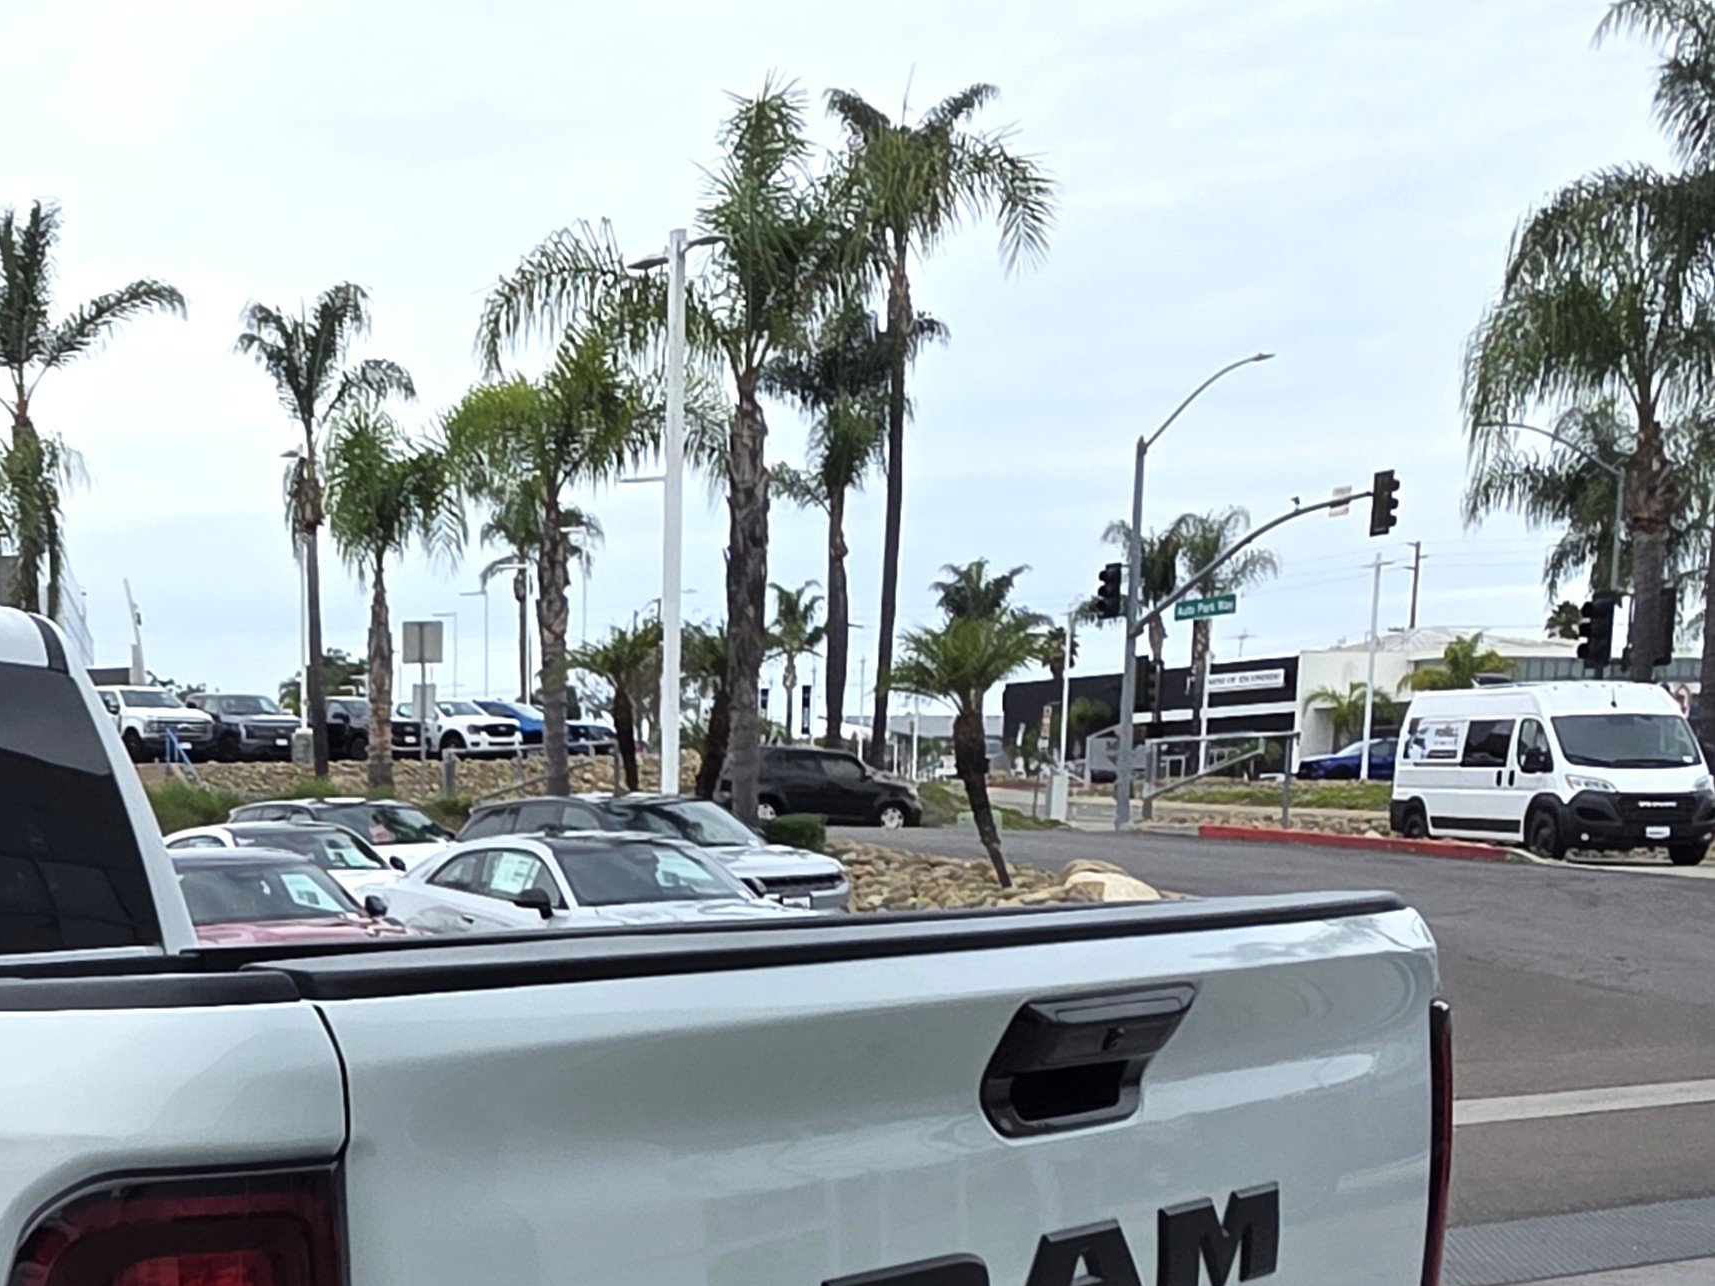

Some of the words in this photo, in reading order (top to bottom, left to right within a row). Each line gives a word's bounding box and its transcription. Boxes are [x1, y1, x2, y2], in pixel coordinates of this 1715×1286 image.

[1177, 604, 1195, 616] Auto
[1197, 602, 1215, 614] Park
[1217, 600, 1234, 611] Way
